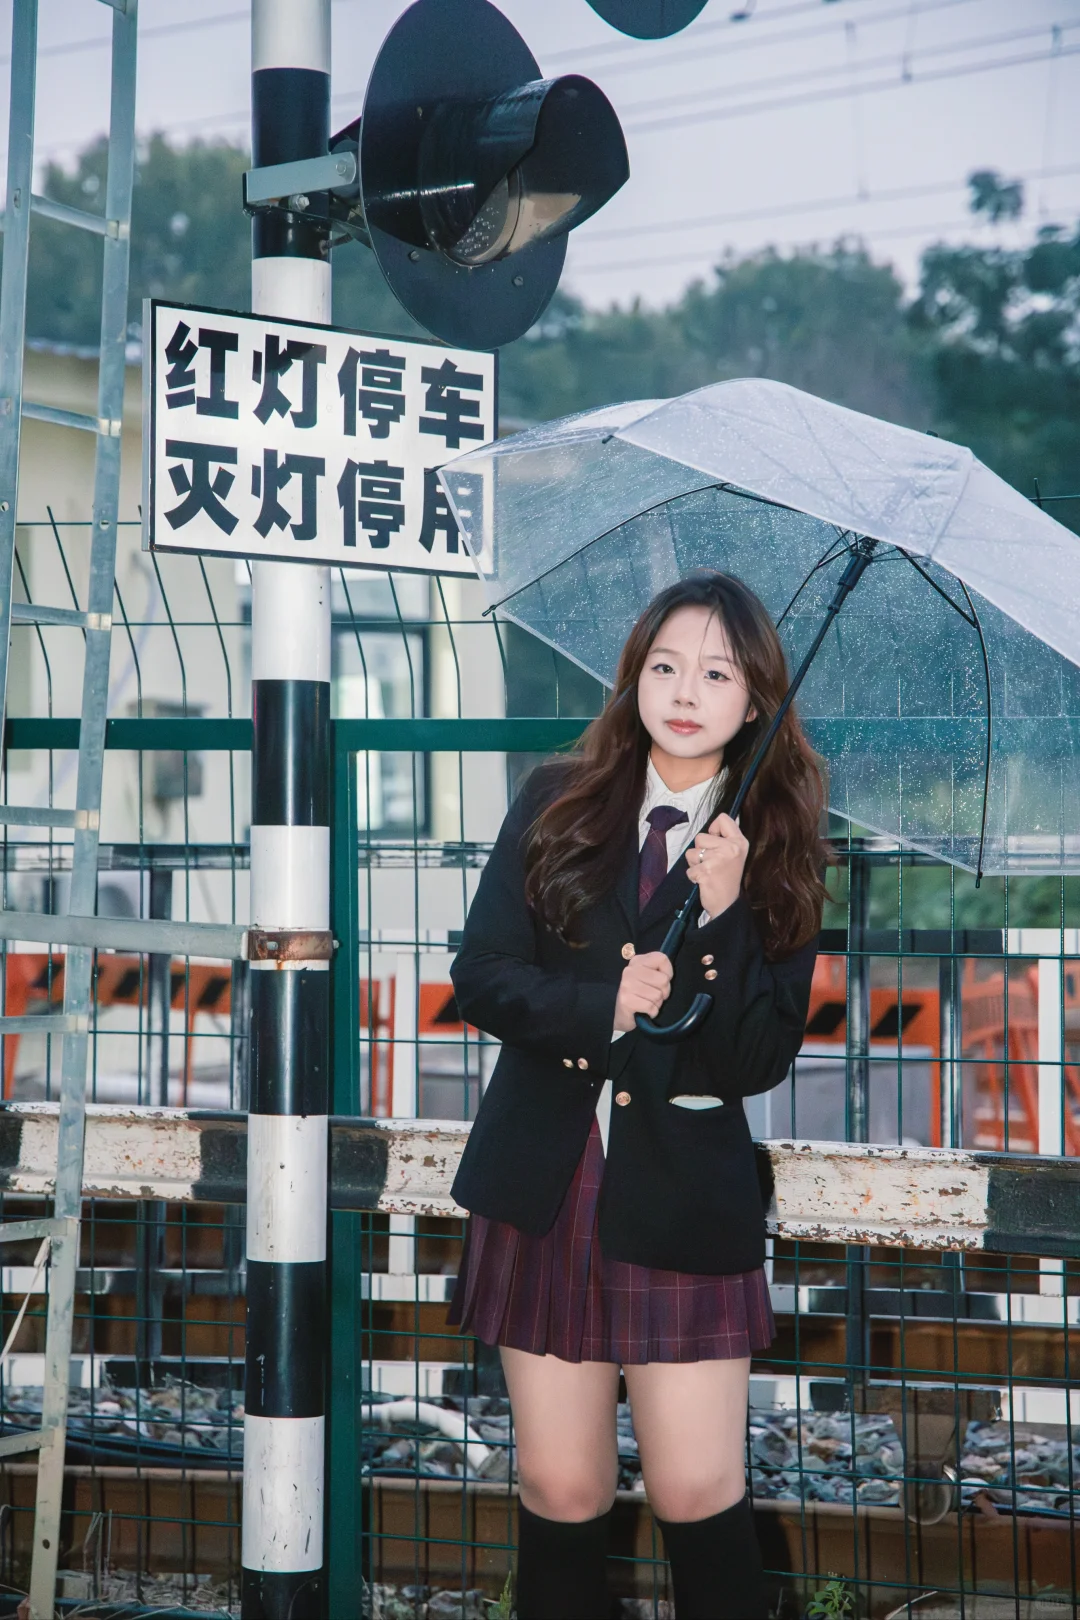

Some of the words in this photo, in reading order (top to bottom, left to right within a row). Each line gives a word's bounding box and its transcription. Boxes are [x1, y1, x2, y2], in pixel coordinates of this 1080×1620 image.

[165, 320, 484, 449] 红灯停车
[164, 439, 484, 556] 灭灯停用
